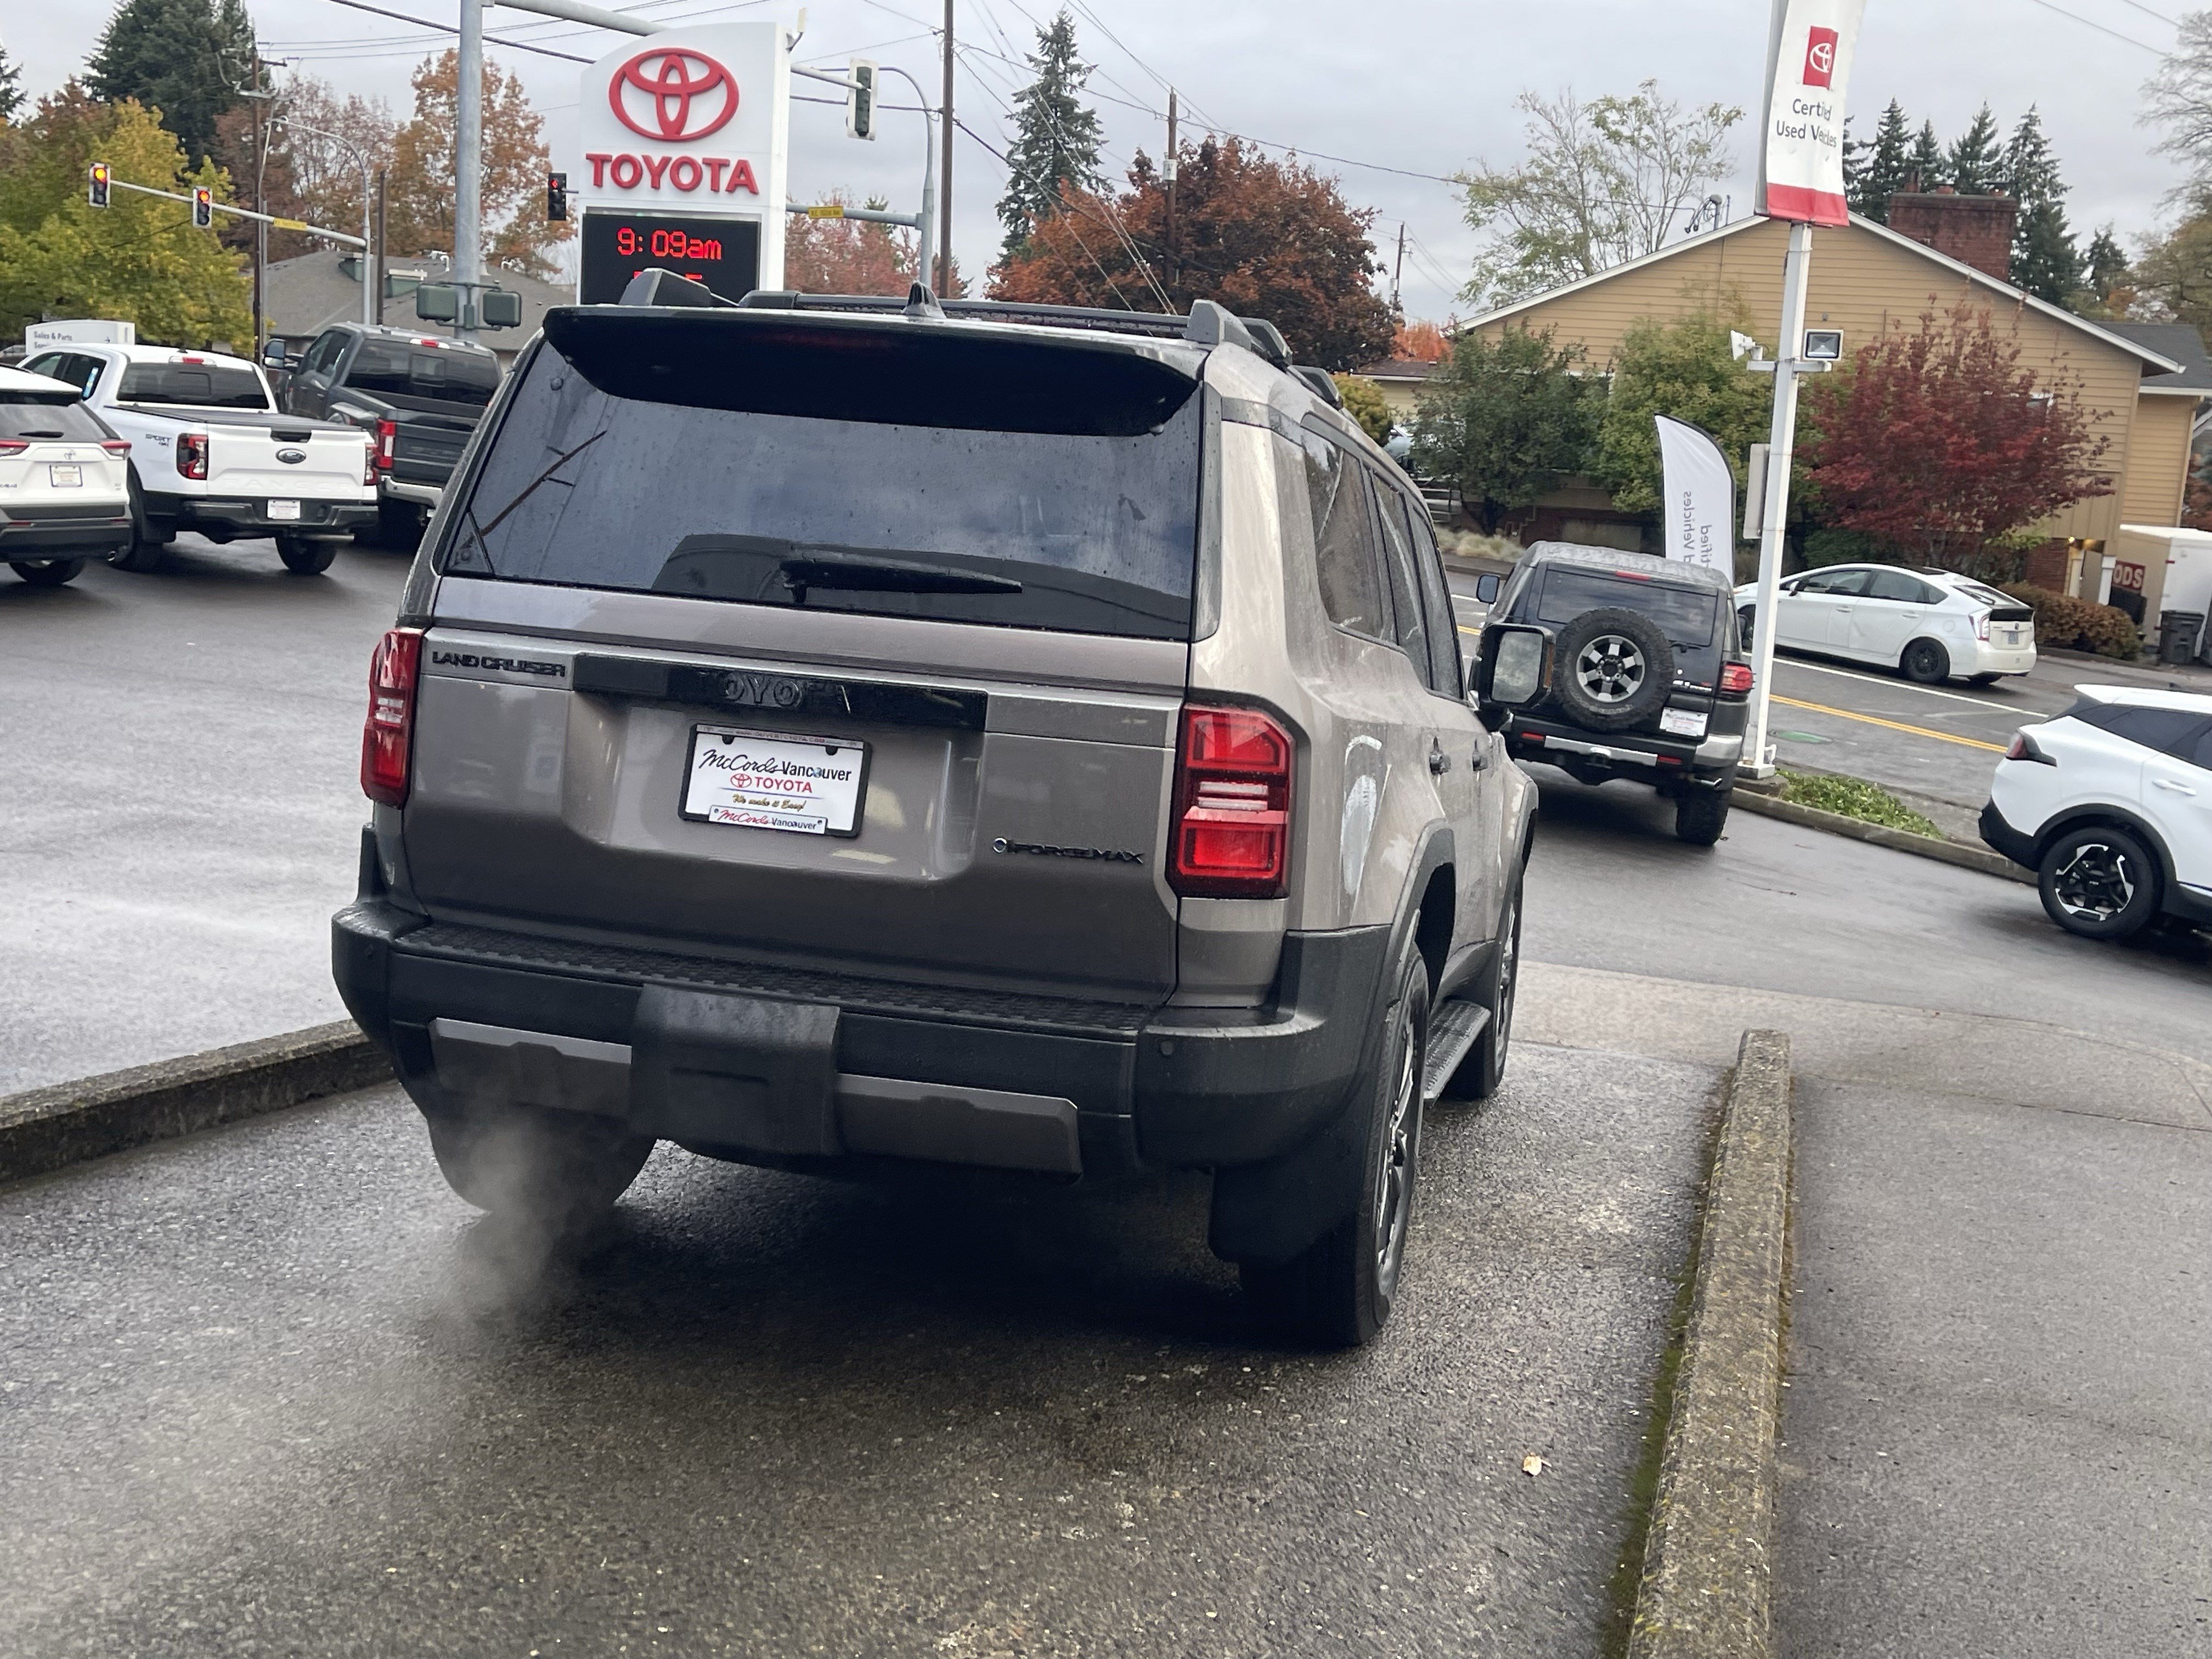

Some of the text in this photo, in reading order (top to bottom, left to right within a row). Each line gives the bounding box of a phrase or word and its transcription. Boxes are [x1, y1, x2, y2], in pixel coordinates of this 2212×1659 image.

[1776, 120, 1806, 139] Used
[585, 153, 759, 195] TOYOTA
[617, 227, 722, 261] 9:09am
[33, 331, 49, 339] Sales
[57, 333, 72, 341] Parts
[2112, 564, 2143, 589] ODS
[432, 651, 566, 678] LAND CRUISER
[698, 749, 851, 781] McCords Vancouver
[755, 777, 812, 793] TOYOTA
[771, 817, 816, 830] Vancouver
